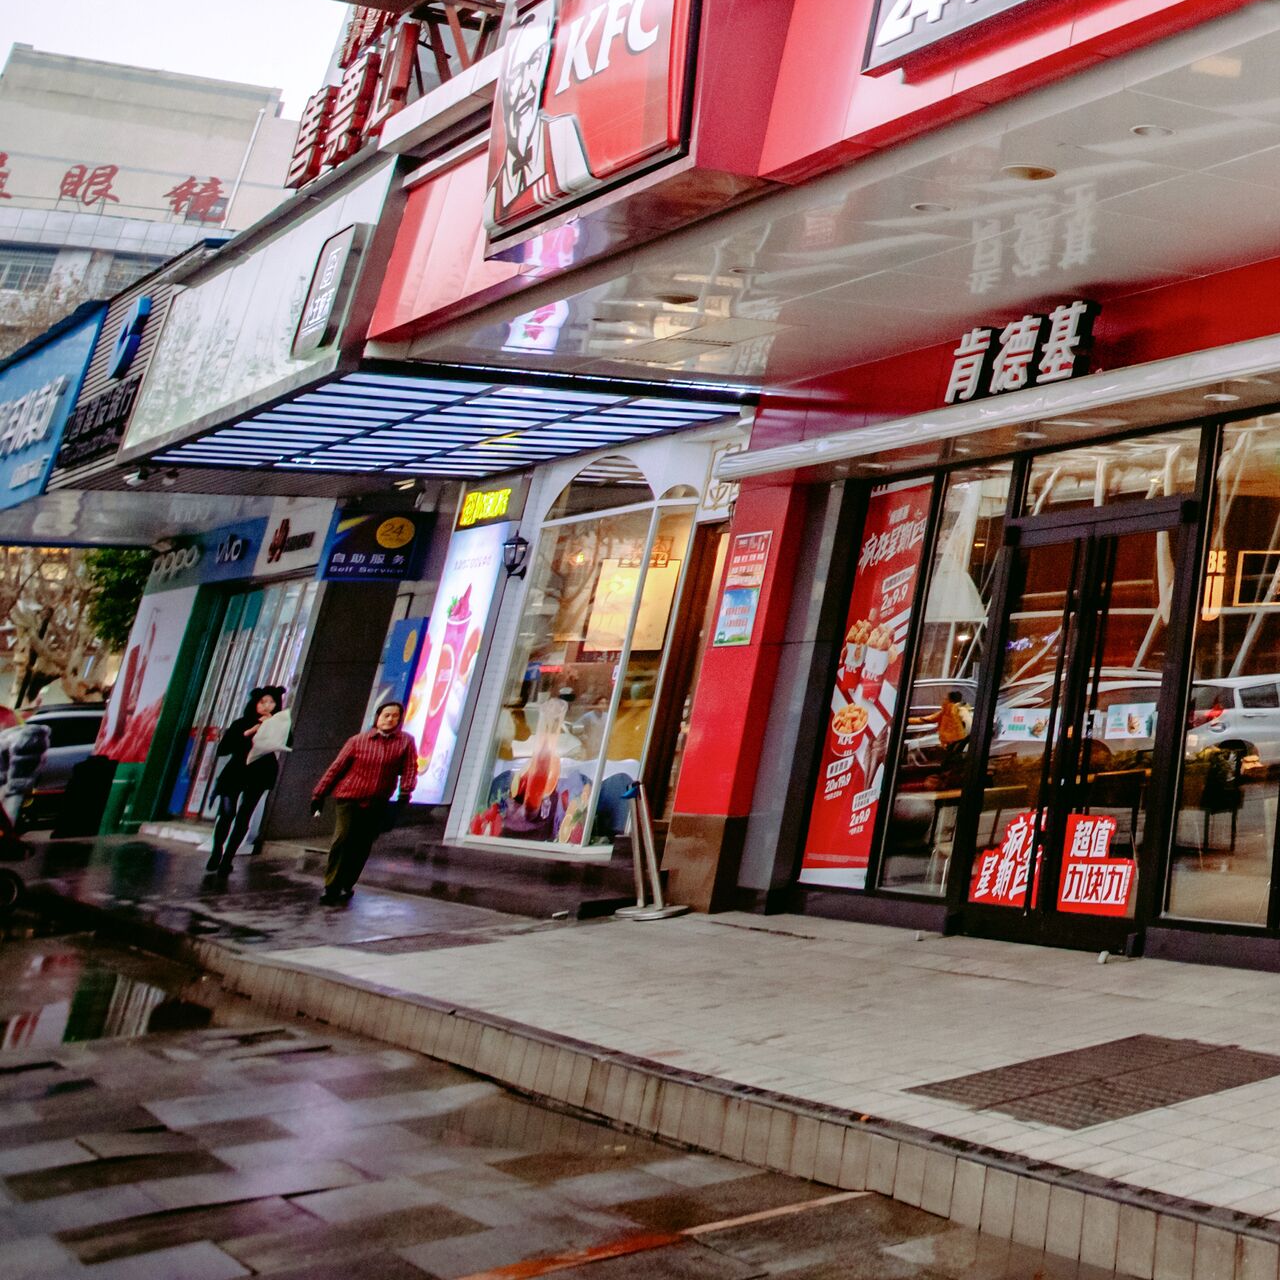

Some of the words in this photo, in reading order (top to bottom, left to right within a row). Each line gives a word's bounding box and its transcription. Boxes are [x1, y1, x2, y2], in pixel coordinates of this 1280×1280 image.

[943, 300, 1089, 404] 肯德基
[332, 552, 406, 566] 自助服务
[859, 515, 928, 578] 疯狂星期四
[330, 566, 354, 574] Self
[1069, 819, 1116, 858] 超值
[1061, 863, 1132, 905] 九块九
